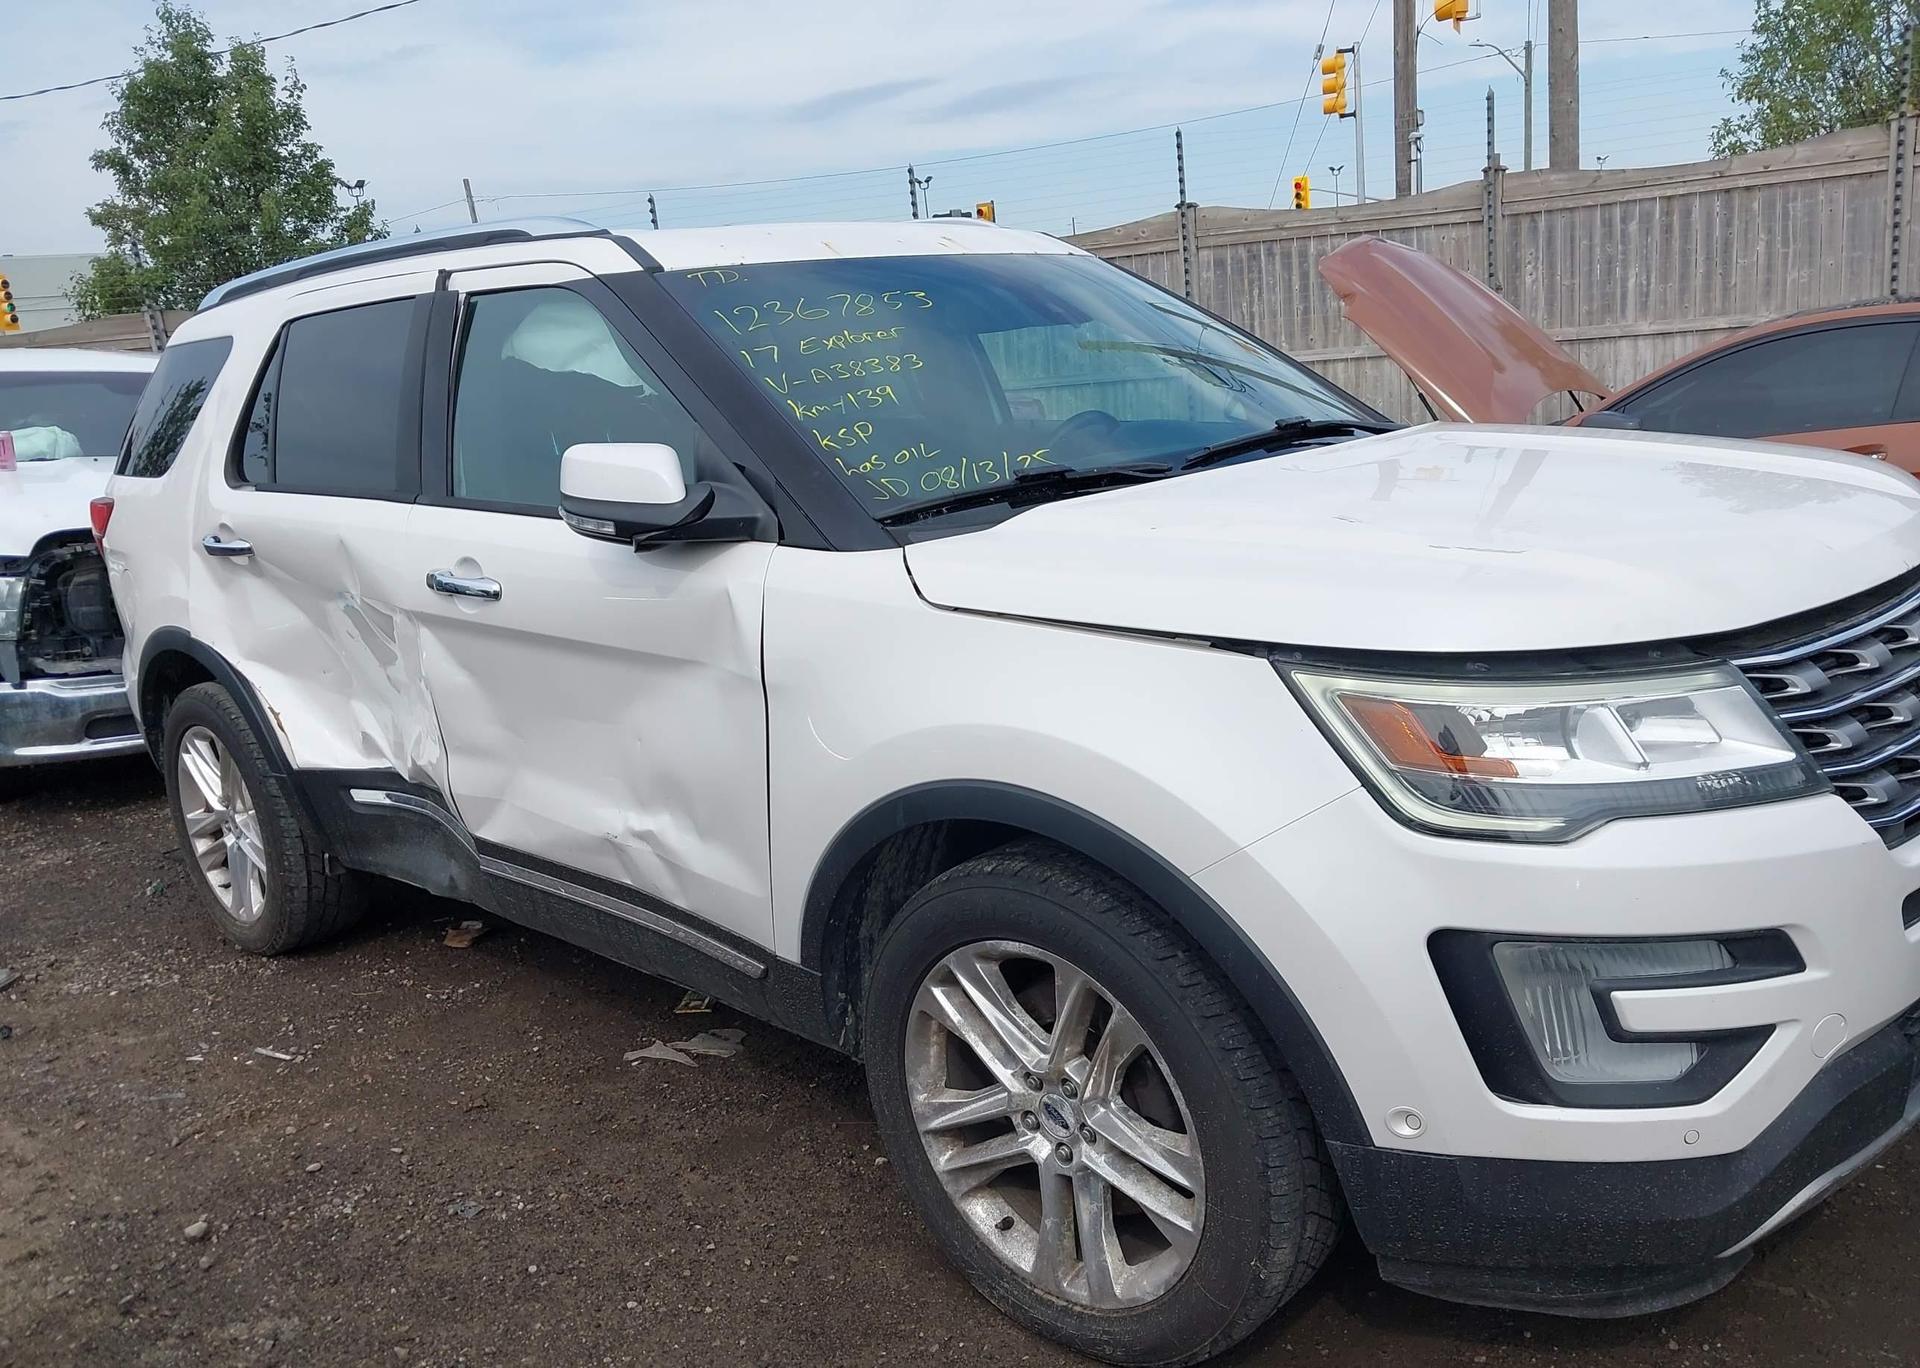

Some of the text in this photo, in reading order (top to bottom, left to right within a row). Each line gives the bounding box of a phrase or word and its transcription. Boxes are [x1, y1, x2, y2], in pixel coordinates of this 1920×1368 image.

[712, 290, 934, 336] 12367853
[739, 325, 906, 370] 17 Explorer
